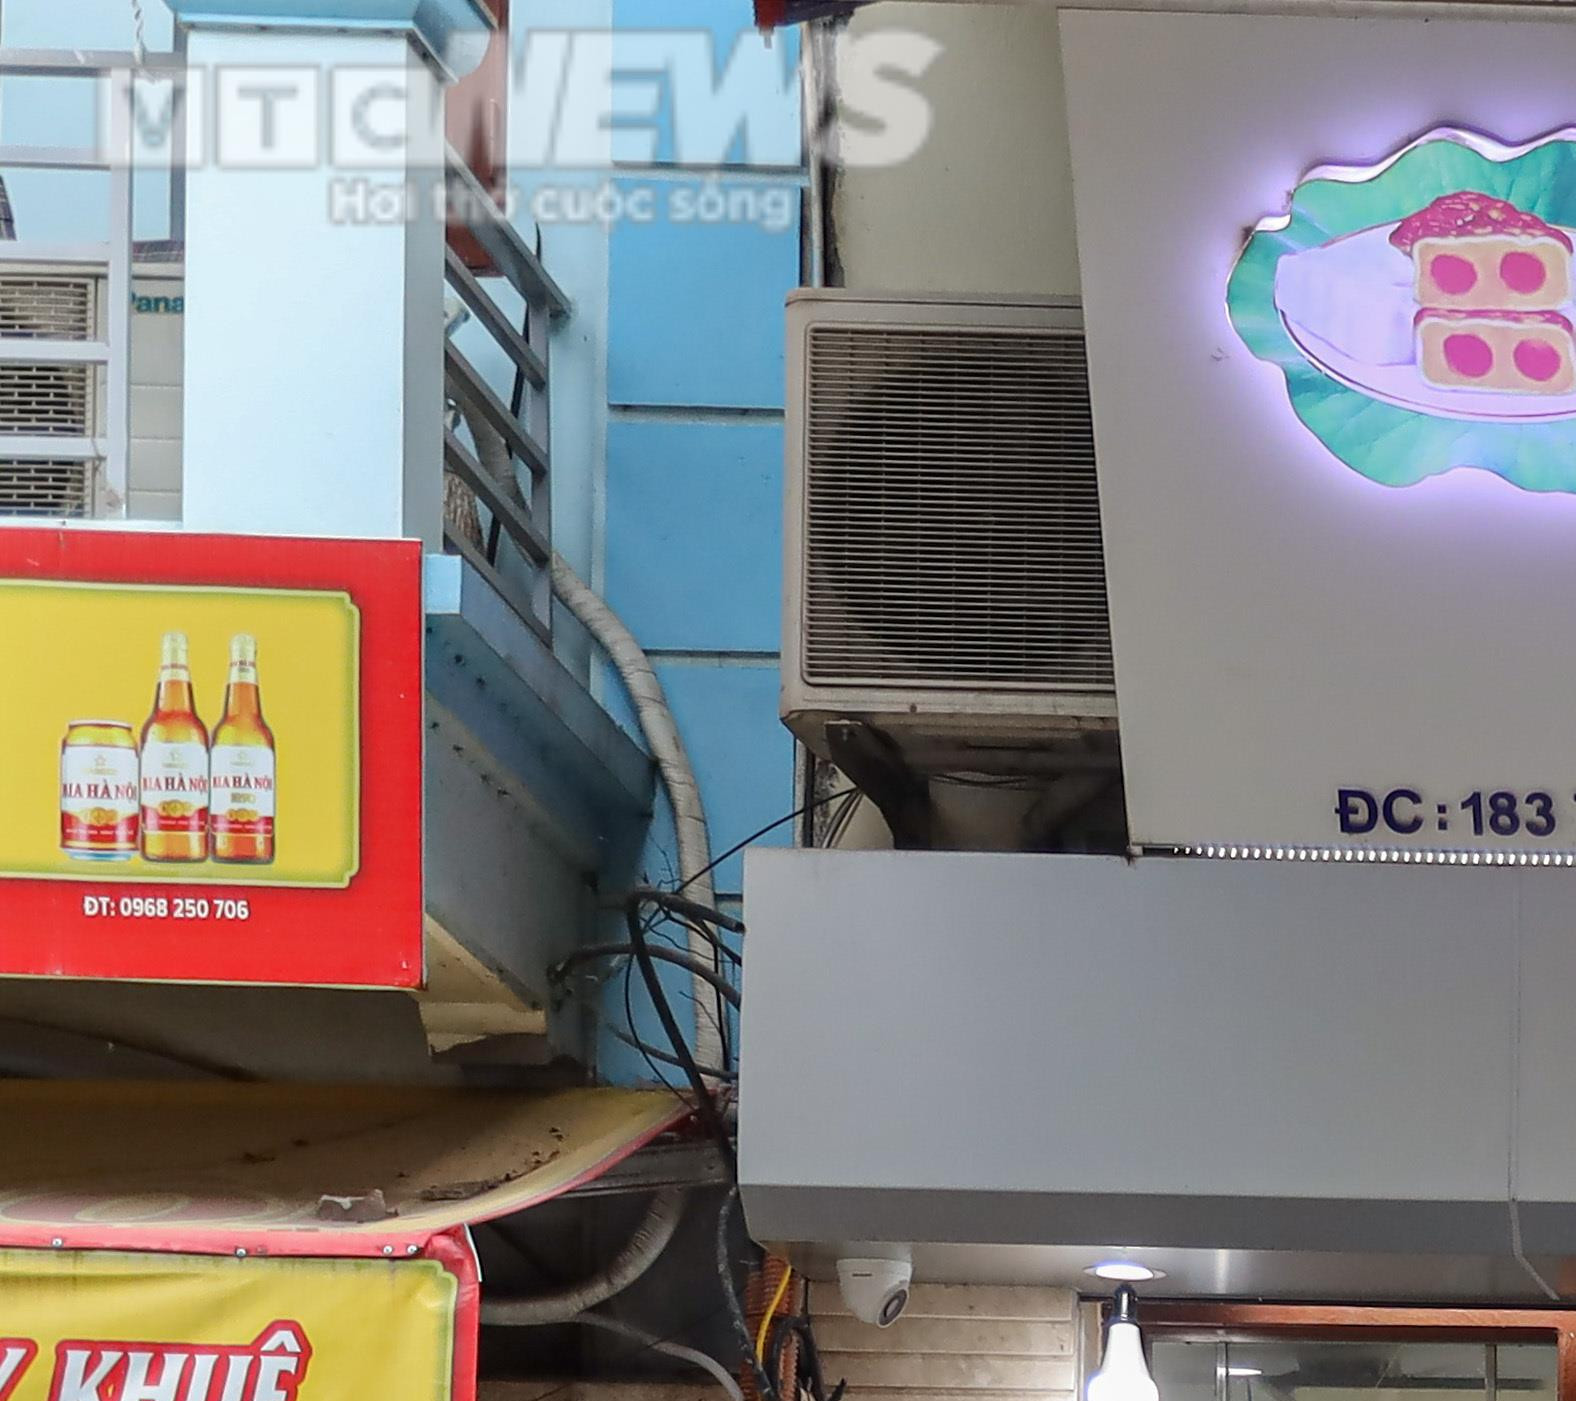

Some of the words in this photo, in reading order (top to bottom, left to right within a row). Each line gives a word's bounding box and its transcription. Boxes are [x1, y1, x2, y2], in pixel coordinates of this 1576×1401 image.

[83, 894, 117, 918] ĐT:
[120, 897, 169, 919] 0968
[172, 897, 210, 920] 250
[213, 898, 250, 921] 706
